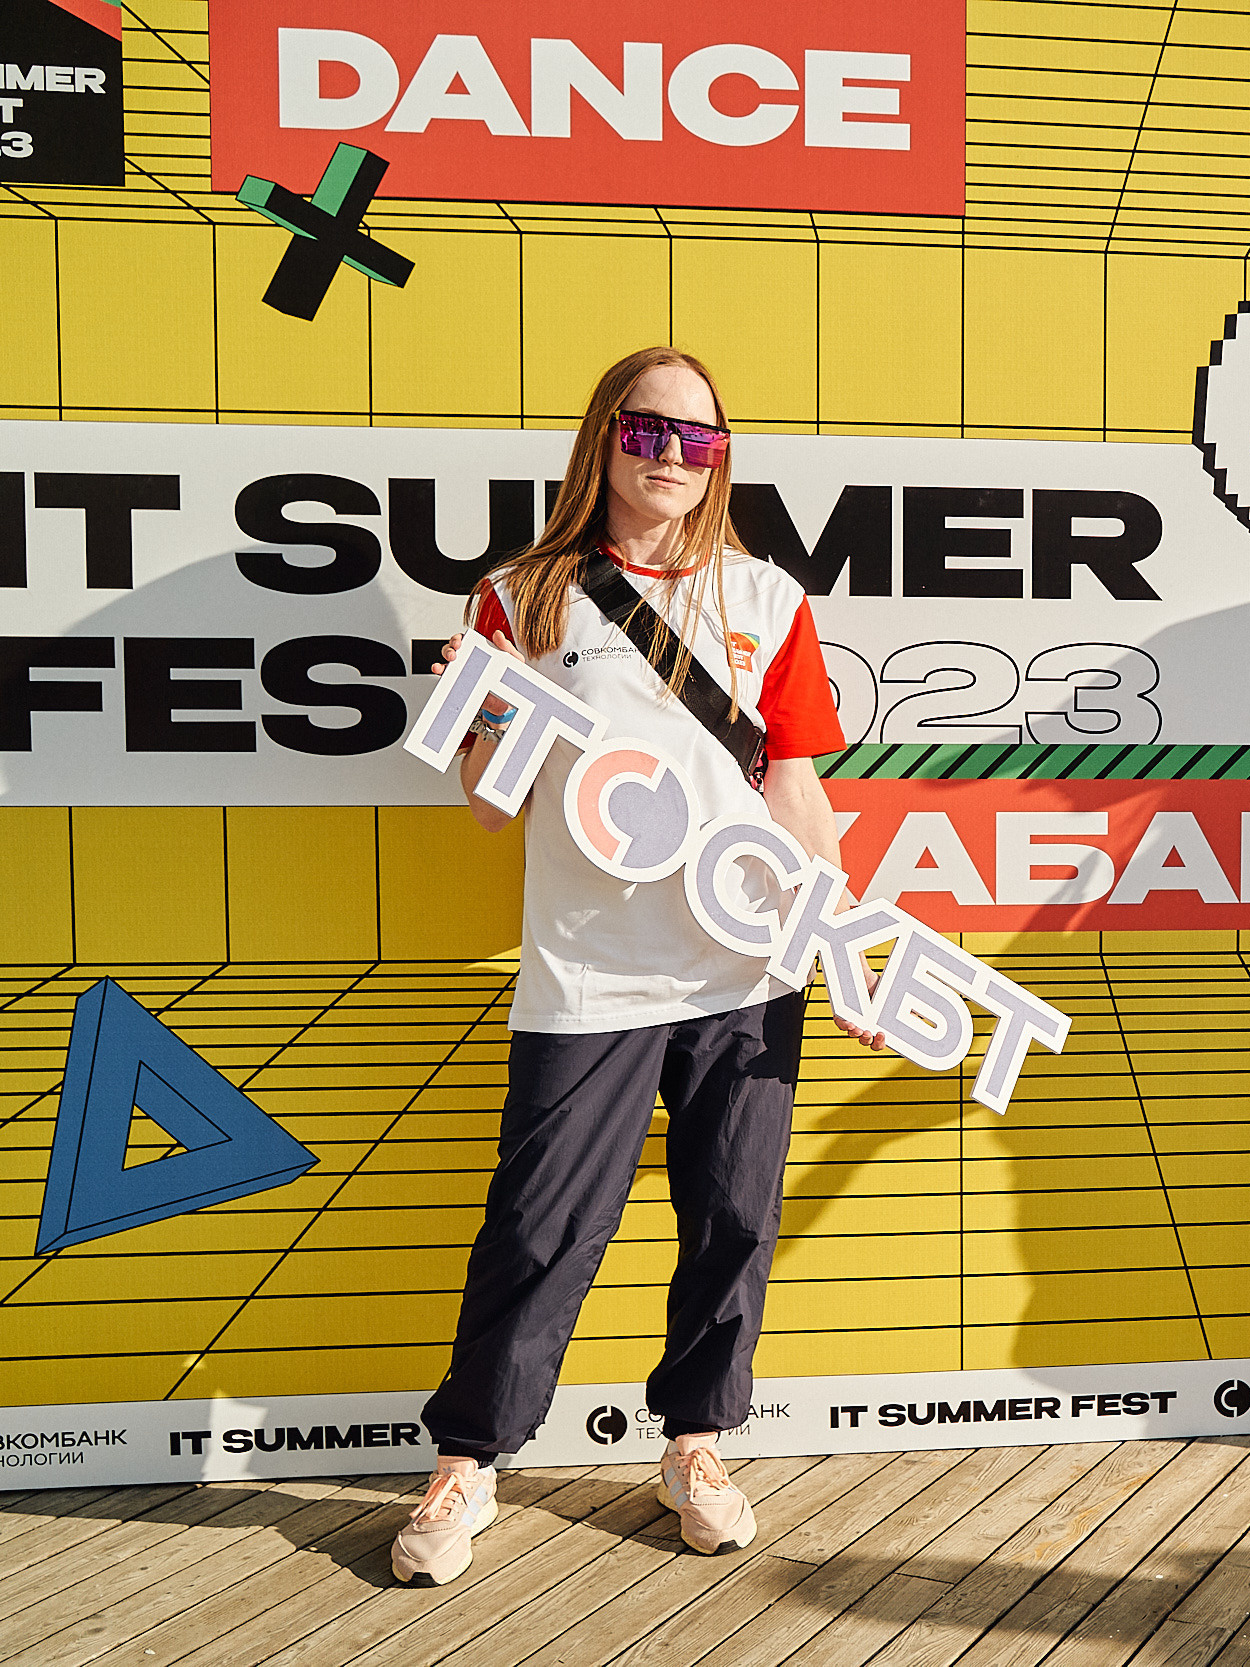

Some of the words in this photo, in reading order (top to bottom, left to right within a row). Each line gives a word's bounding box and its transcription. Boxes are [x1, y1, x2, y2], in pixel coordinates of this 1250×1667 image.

[0, 63, 106, 94] MER
[278, 27, 911, 150] DANCE
[0, 471, 181, 590] IT
[234, 473, 1164, 601] SUMER
[581, 646, 638, 656] СОВКОМБА
[582, 653, 632, 662] ТЕХНОЛОГИИ
[829, 1405, 868, 1428] IT
[878, 1396, 1061, 1427] SUMMER
[1071, 1390, 1177, 1418] FEST
[170, 1431, 212, 1456] IT
[222, 1422, 421, 1454] SUMMER
